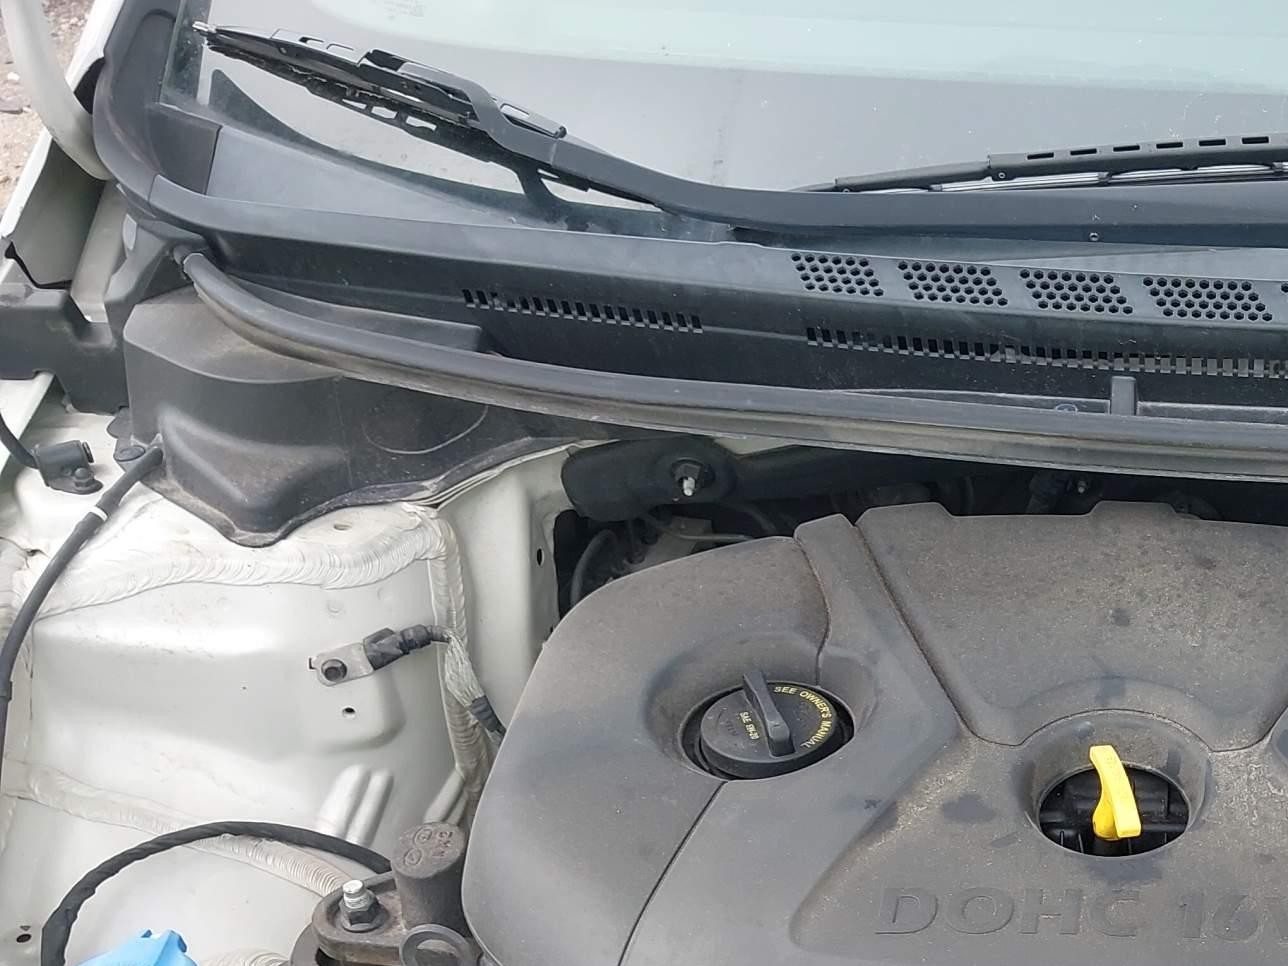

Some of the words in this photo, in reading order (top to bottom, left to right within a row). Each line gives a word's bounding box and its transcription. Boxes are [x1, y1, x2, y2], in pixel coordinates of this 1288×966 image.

[774, 686, 797, 695] SEE
[739, 711, 751, 723] SAE
[799, 691, 832, 718] OWNER'S
[800, 720, 832, 748] MANUAL
[874, 887, 1139, 937] DOHC
